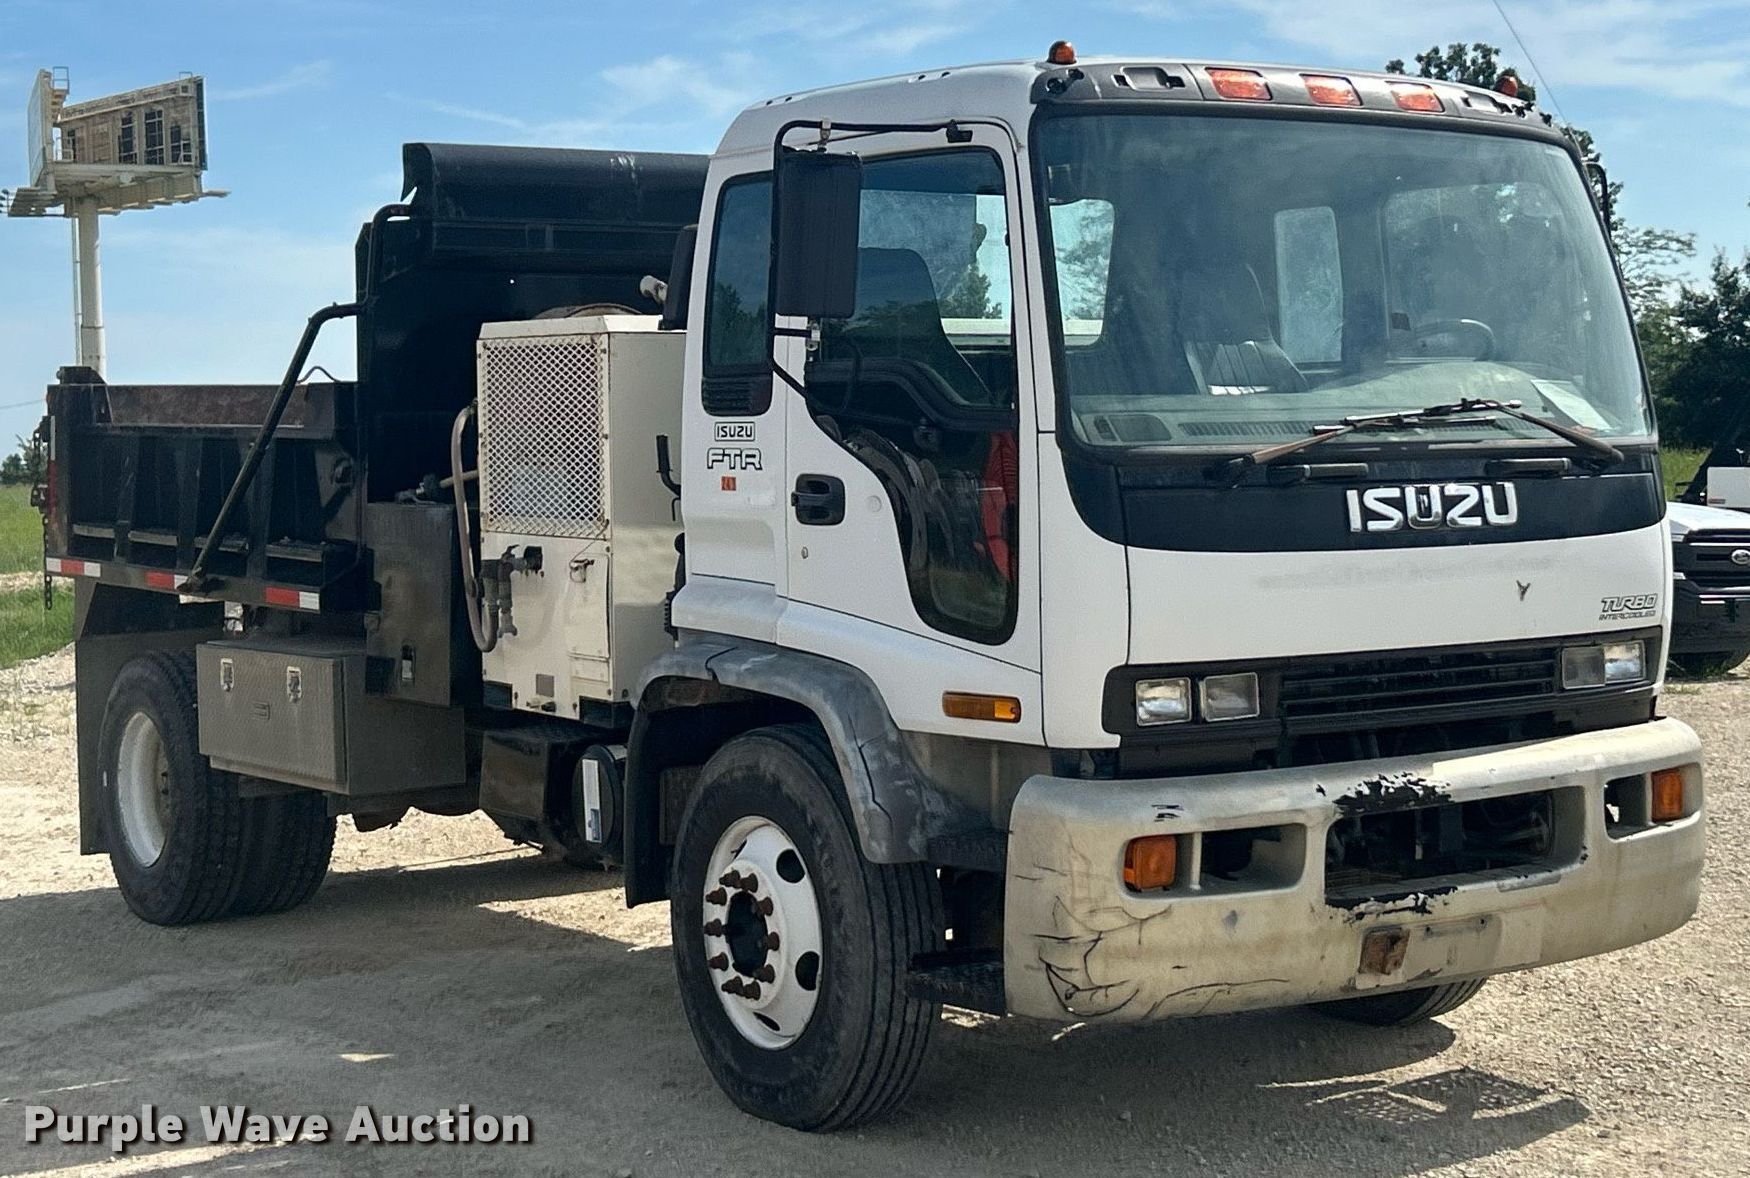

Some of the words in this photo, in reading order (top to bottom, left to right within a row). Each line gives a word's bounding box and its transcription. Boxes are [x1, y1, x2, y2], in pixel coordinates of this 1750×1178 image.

[716, 425, 753, 438] ISUZU
[706, 447, 763, 471] FTR
[1346, 482, 1518, 533] ISUZU
[1601, 593, 1658, 612] TURBO
[1599, 610, 1656, 621] INTERCOOLED
